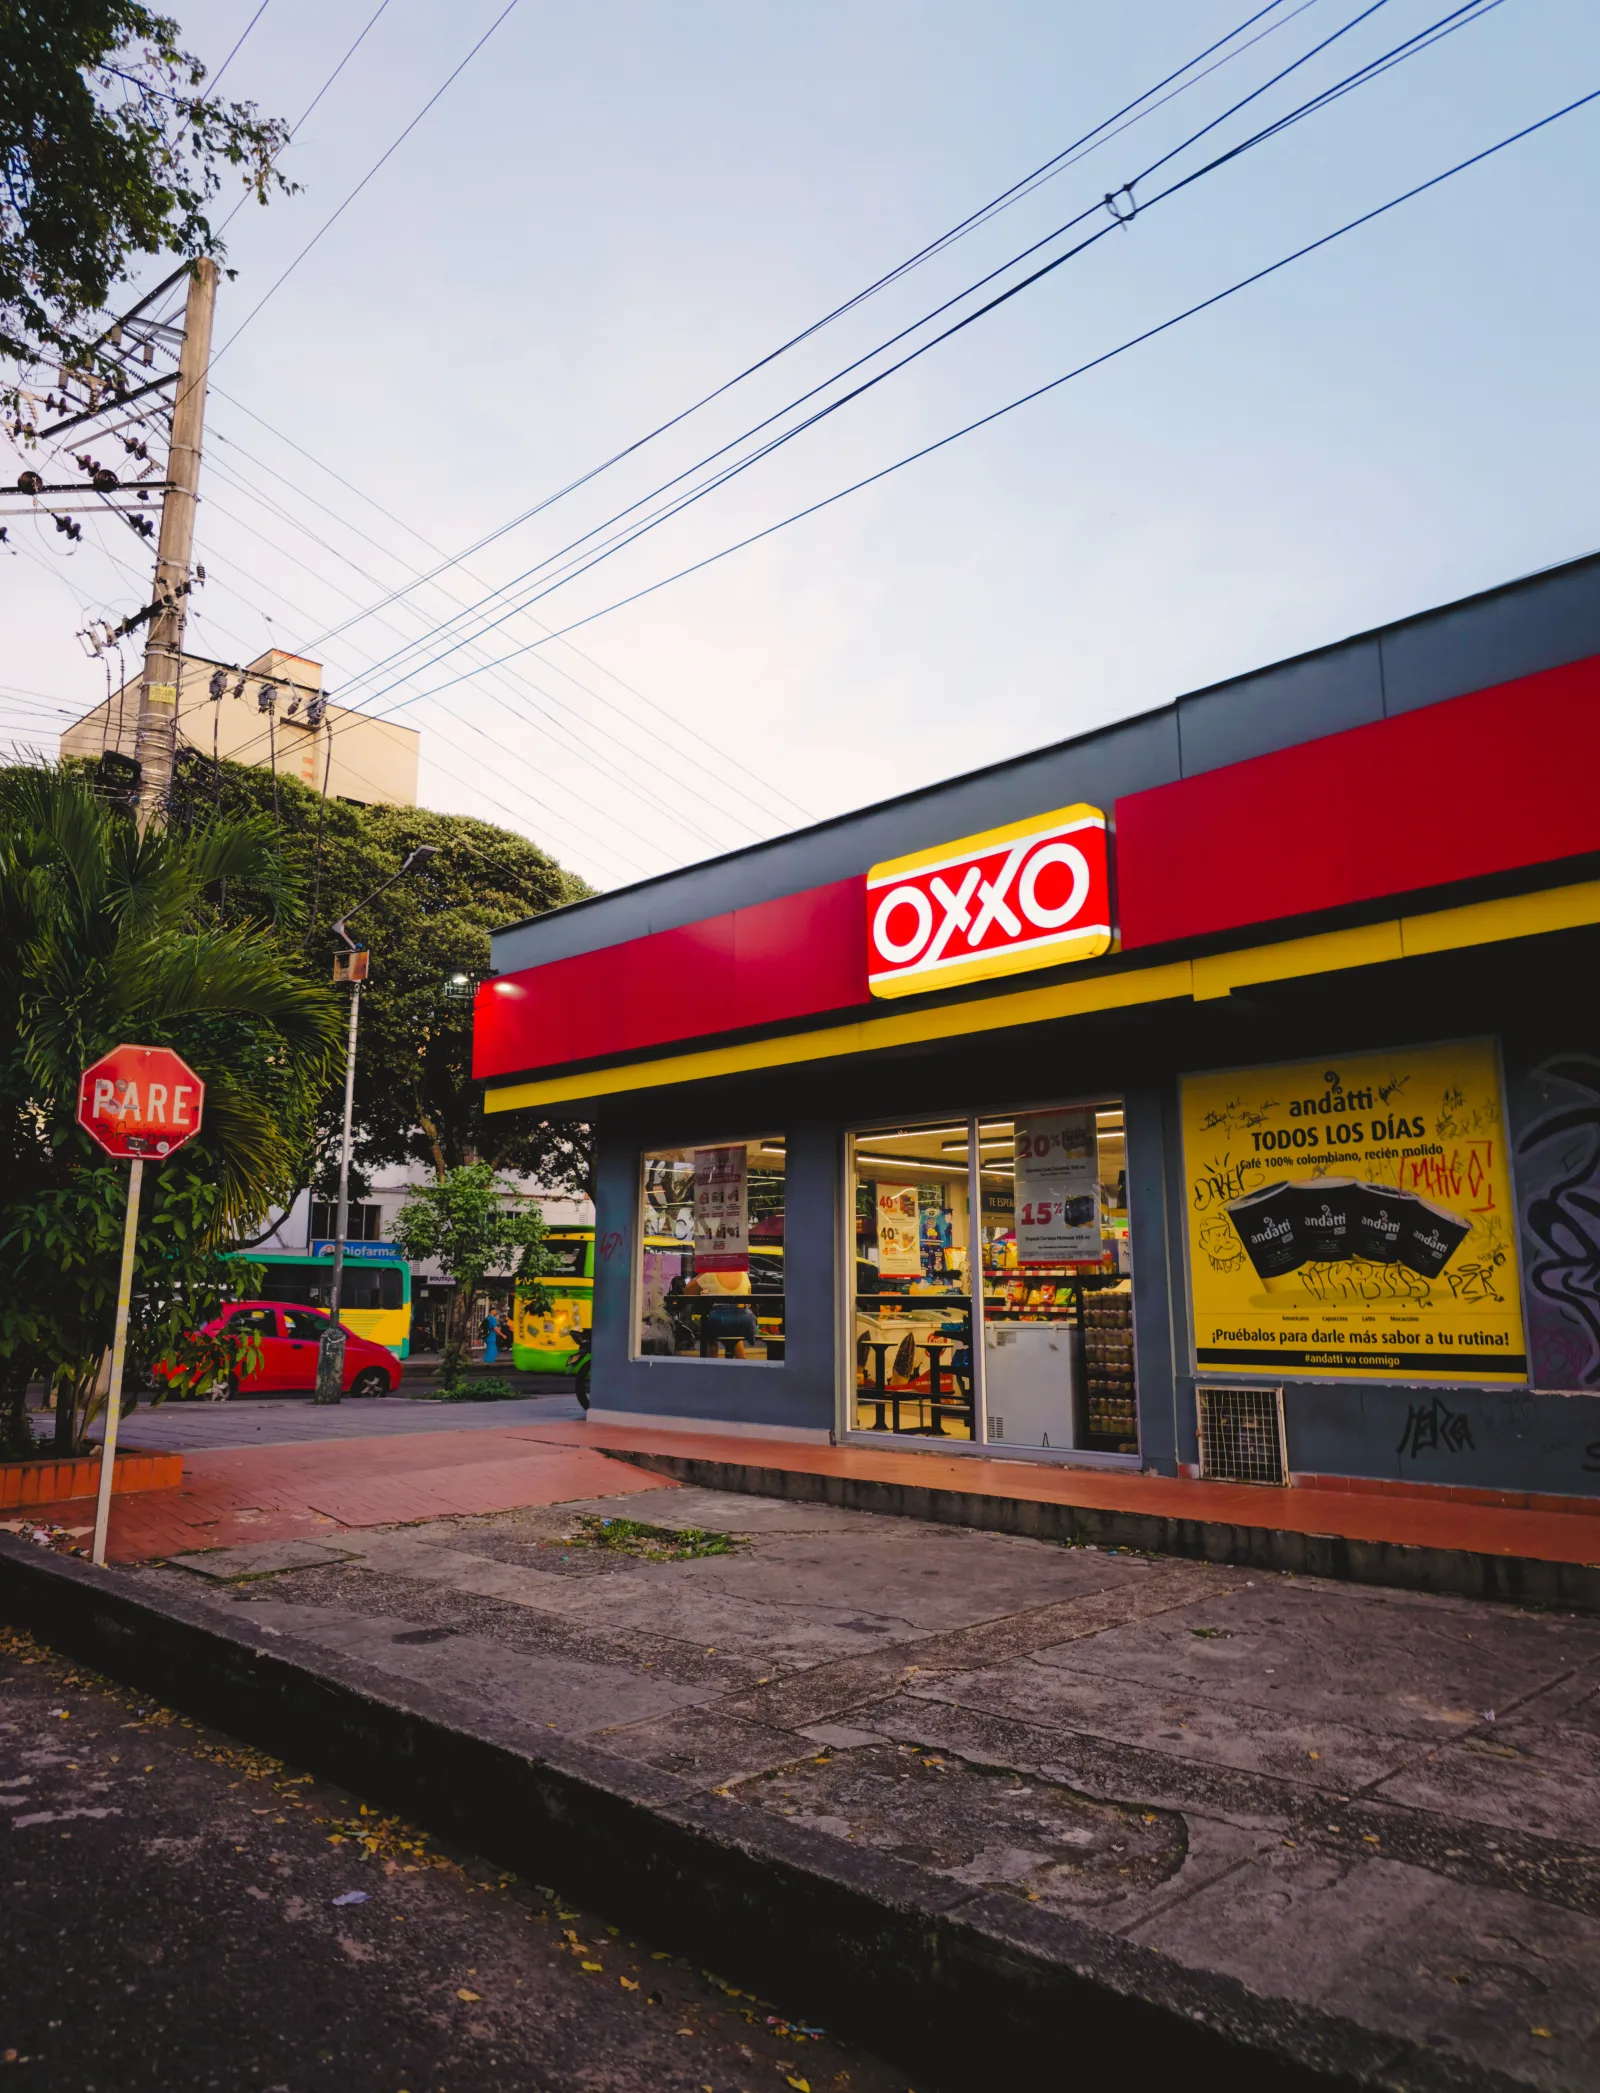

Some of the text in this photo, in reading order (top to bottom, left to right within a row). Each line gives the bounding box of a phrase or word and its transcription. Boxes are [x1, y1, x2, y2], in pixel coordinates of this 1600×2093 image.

[873, 842, 1090, 963] OXXO
[92, 1078, 193, 1125] PARE
[1289, 1087, 1373, 1117] andatti
[1252, 1126, 1319, 1151] TODOS
[1326, 1122, 1364, 1145] LOS
[1372, 1113, 1426, 1141] DÍAS
[1018, 1134, 1061, 1159] 20%
[1240, 1143, 1444, 1169] Café 100% colombiano, recién molido
[1021, 1202, 1063, 1226] 15%
[1304, 1212, 1346, 1227] andatti
[1361, 1214, 1401, 1234] andatti
[1251, 1218, 1292, 1244] andatti
[1413, 1228, 1449, 1254] andatti
[1211, 1328, 1511, 1347] ¡Pruébalos para darle más sabor a tu rutina!
[1304, 1352, 1400, 1368] #andatti va conmigo
